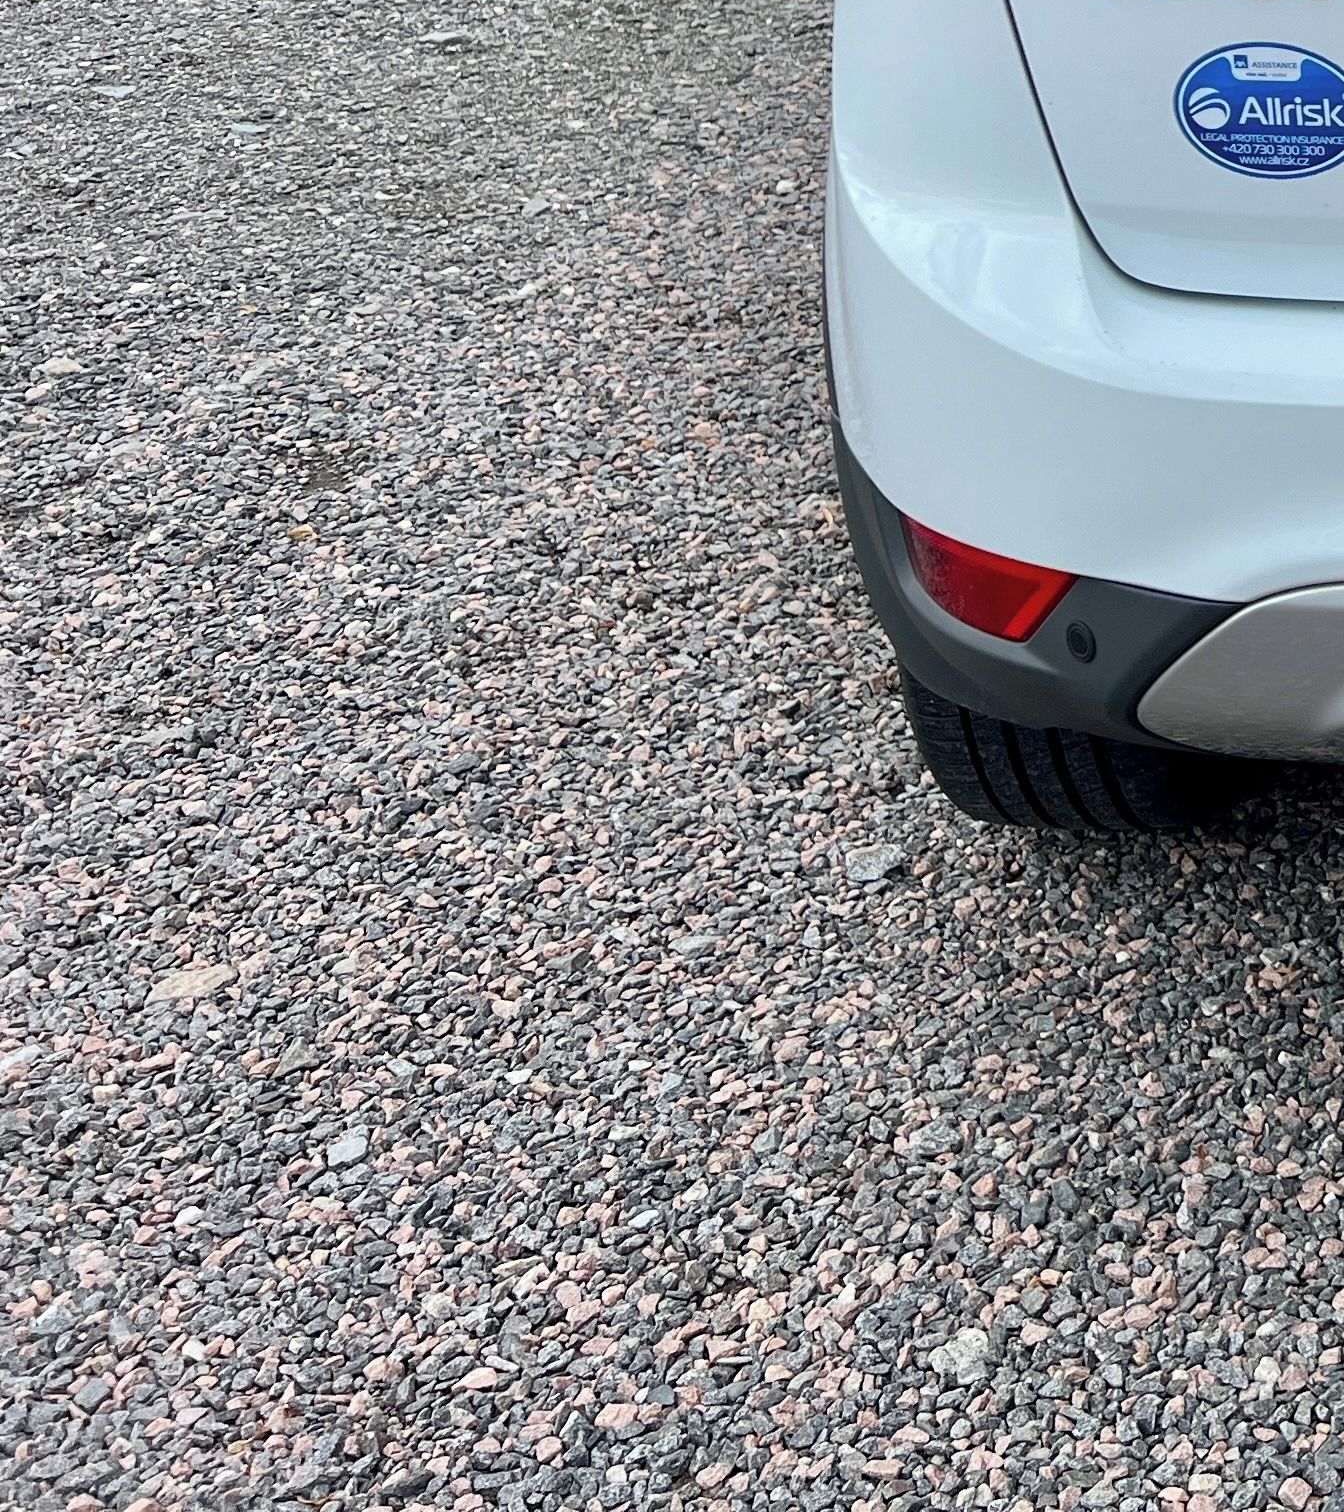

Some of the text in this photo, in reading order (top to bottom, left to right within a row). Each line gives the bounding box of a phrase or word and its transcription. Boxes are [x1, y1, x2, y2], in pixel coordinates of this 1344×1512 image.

[1200, 133, 1344, 145] LEGAL PROTECTION INSURANCE
[1222, 143, 1325, 156] +420 730 300 300
[1239, 156, 1309, 166] www.allrisk.cz
